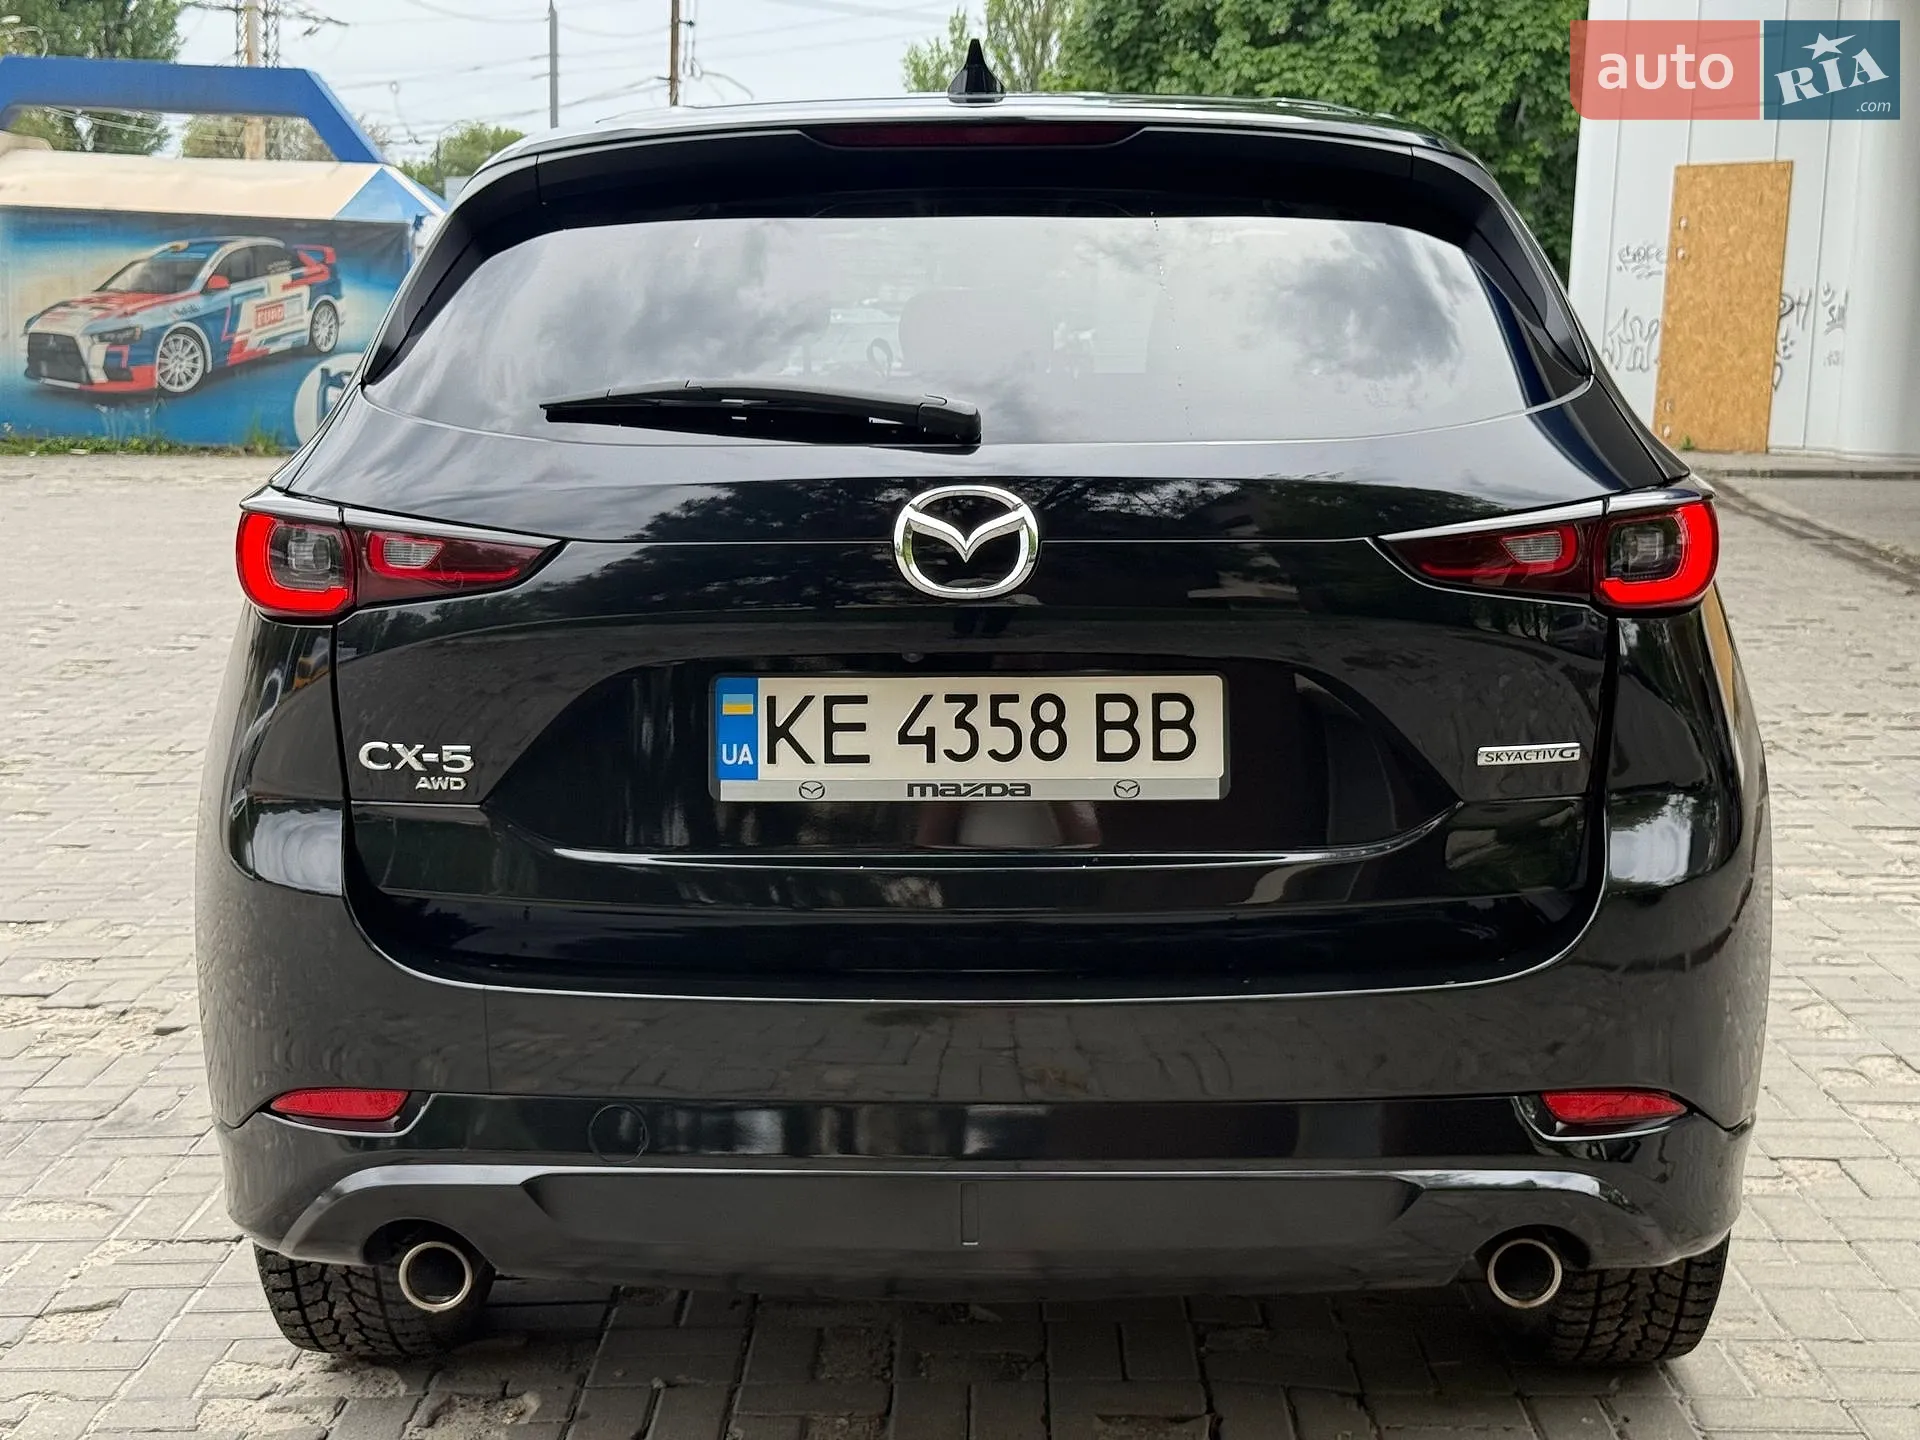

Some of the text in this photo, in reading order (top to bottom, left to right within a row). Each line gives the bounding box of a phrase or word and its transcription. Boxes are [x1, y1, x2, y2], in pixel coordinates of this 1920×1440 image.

[766, 692, 1197, 765] KE 4358 BB
[358, 741, 475, 774] CX-5
[722, 742, 754, 766] UA
[415, 776, 467, 791] AWD
